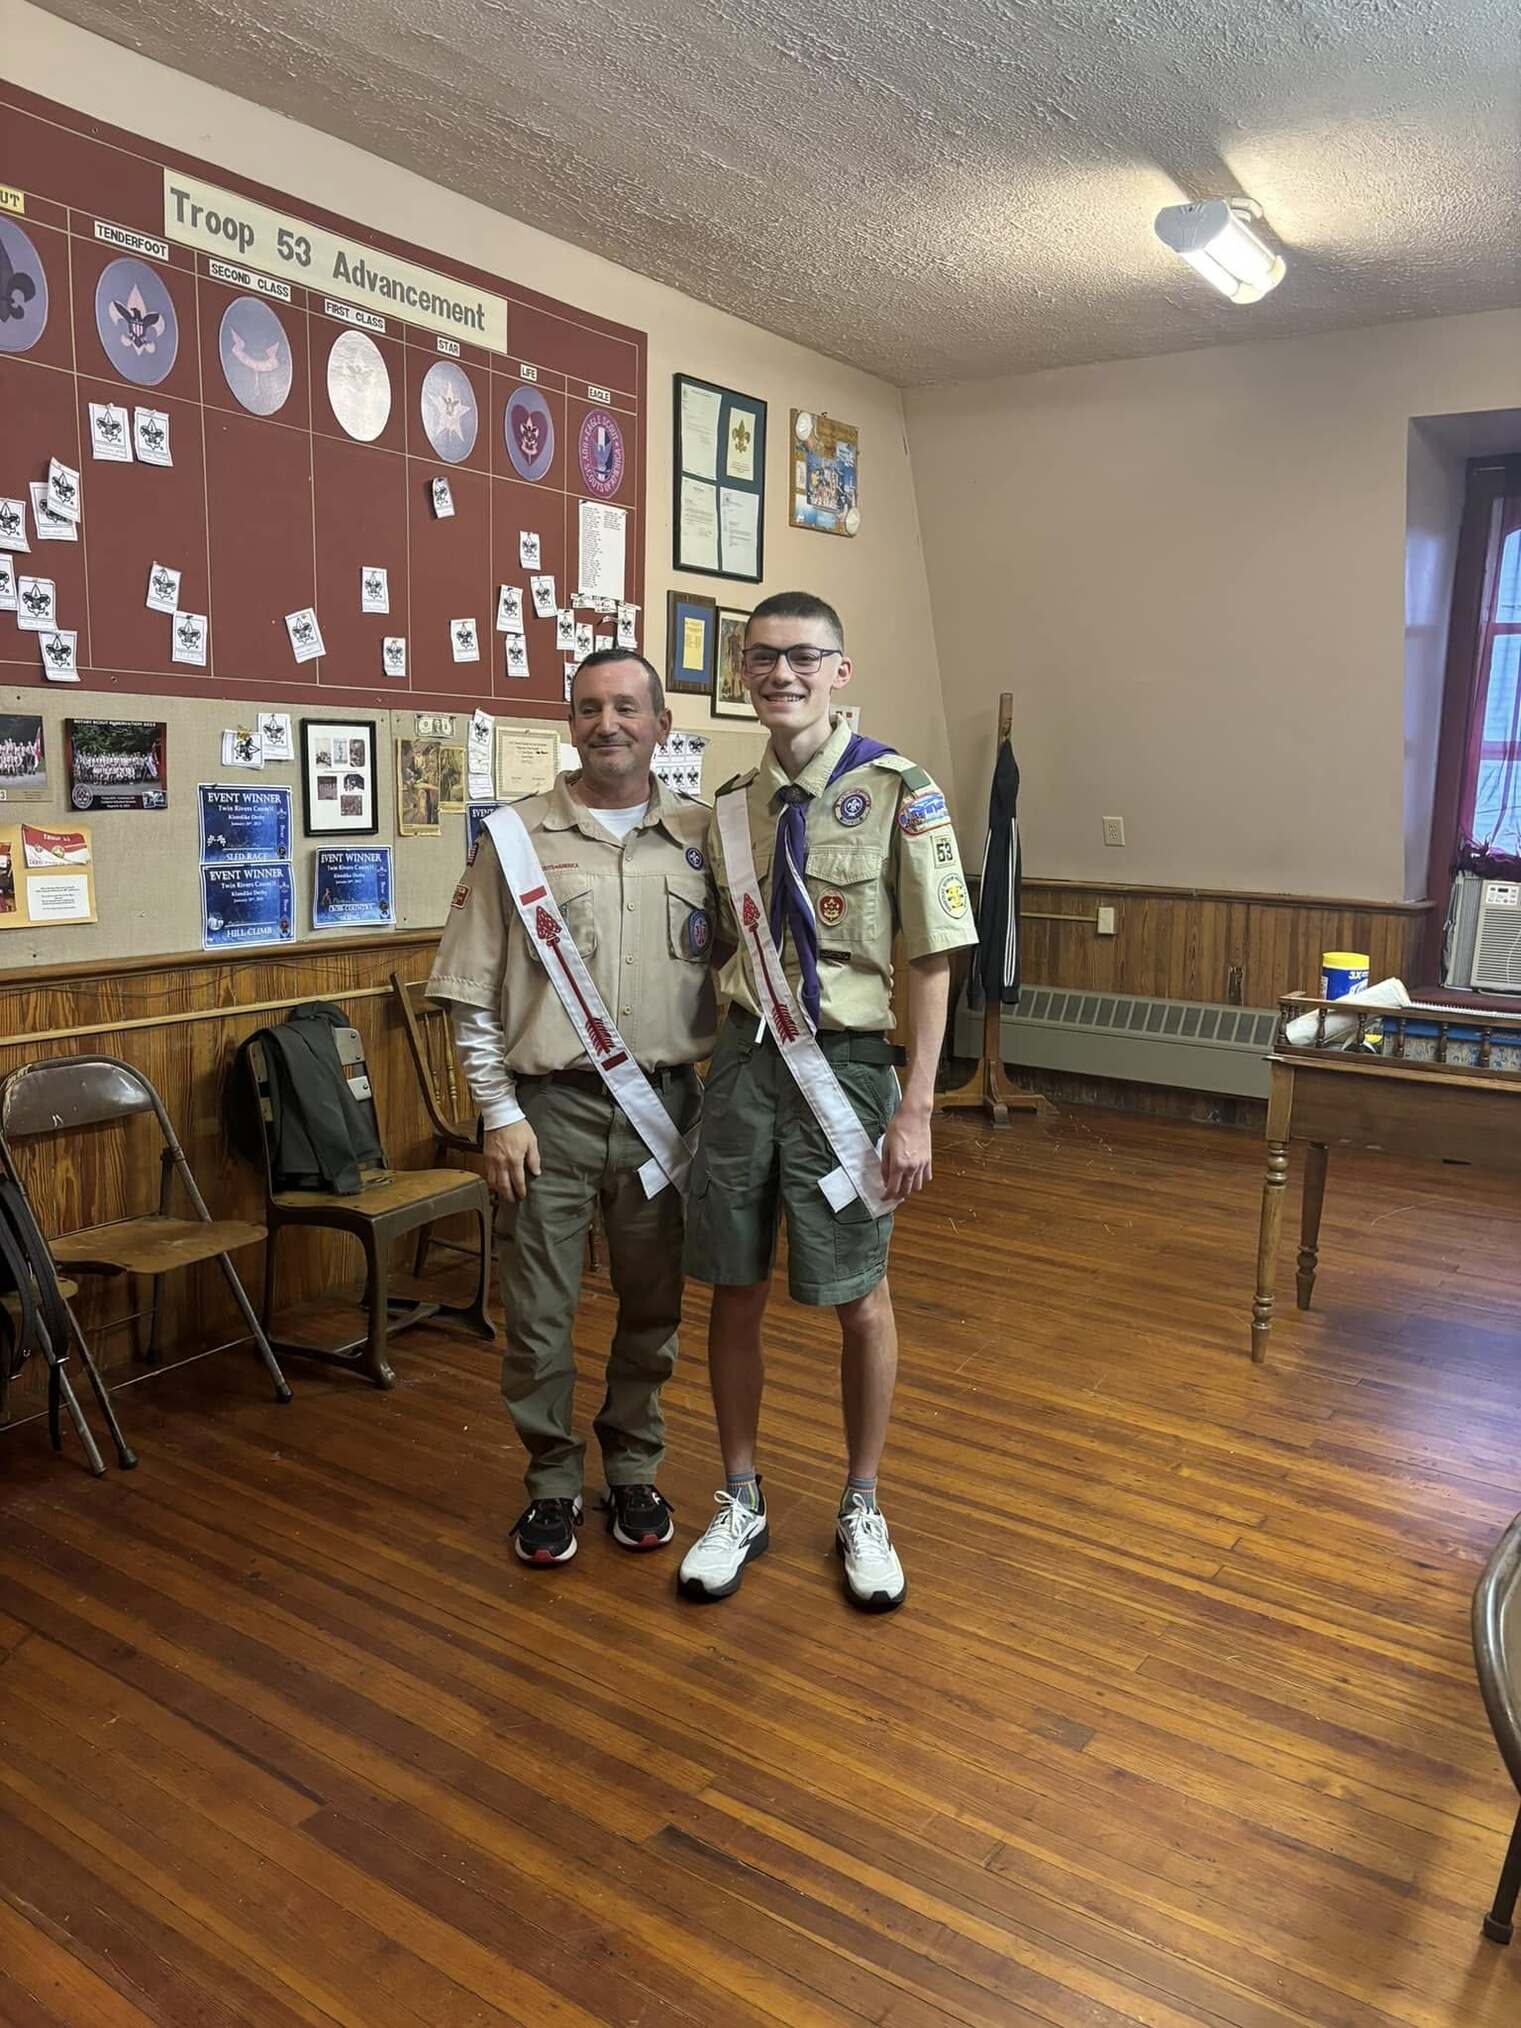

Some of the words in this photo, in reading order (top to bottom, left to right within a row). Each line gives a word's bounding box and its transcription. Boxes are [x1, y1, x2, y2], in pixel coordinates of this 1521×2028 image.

[97, 224, 168, 257] TENDERFOOT
[170, 186, 254, 253] Troop
[277, 228, 312, 267] 53
[333, 250, 486, 332] Advancement
[211, 263, 251, 285] SECOND
[257, 279, 289, 298] CLASS
[326, 303, 350, 318] FIRST
[356, 312, 384, 330] CLASS
[438, 339, 459, 355] STAR
[522, 366, 536, 379] LIFE
[589, 388, 609, 402] EAGLE
[208, 792, 240, 803] EVENT
[242, 792, 281, 804] WINNER
[321, 853, 344, 863] EVENT
[345, 853, 382, 863] WINNER
[936, 842, 953, 862] 53
[210, 870, 241, 881] EVENT
[244, 868, 284, 878] WINNER
[227, 929, 246, 938] HILL
[247, 927, 272, 936] CLIMB
